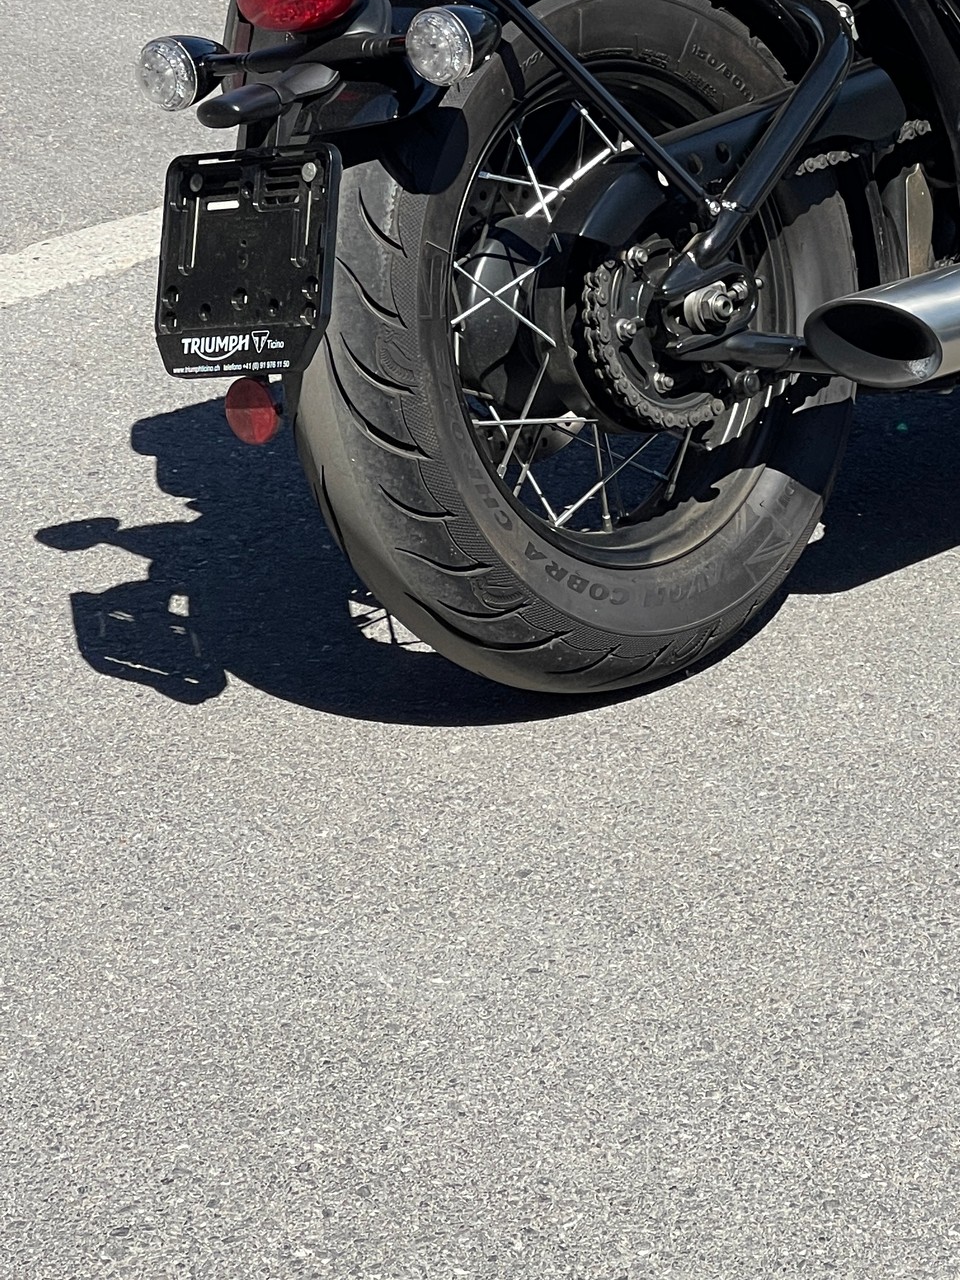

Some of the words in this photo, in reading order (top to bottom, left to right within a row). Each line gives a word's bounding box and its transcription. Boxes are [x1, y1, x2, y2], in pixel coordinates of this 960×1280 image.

[181, 334, 250, 360] TRIUMPH
[267, 339, 285, 349] Ticino
[522, 538, 630, 608] COBRA
